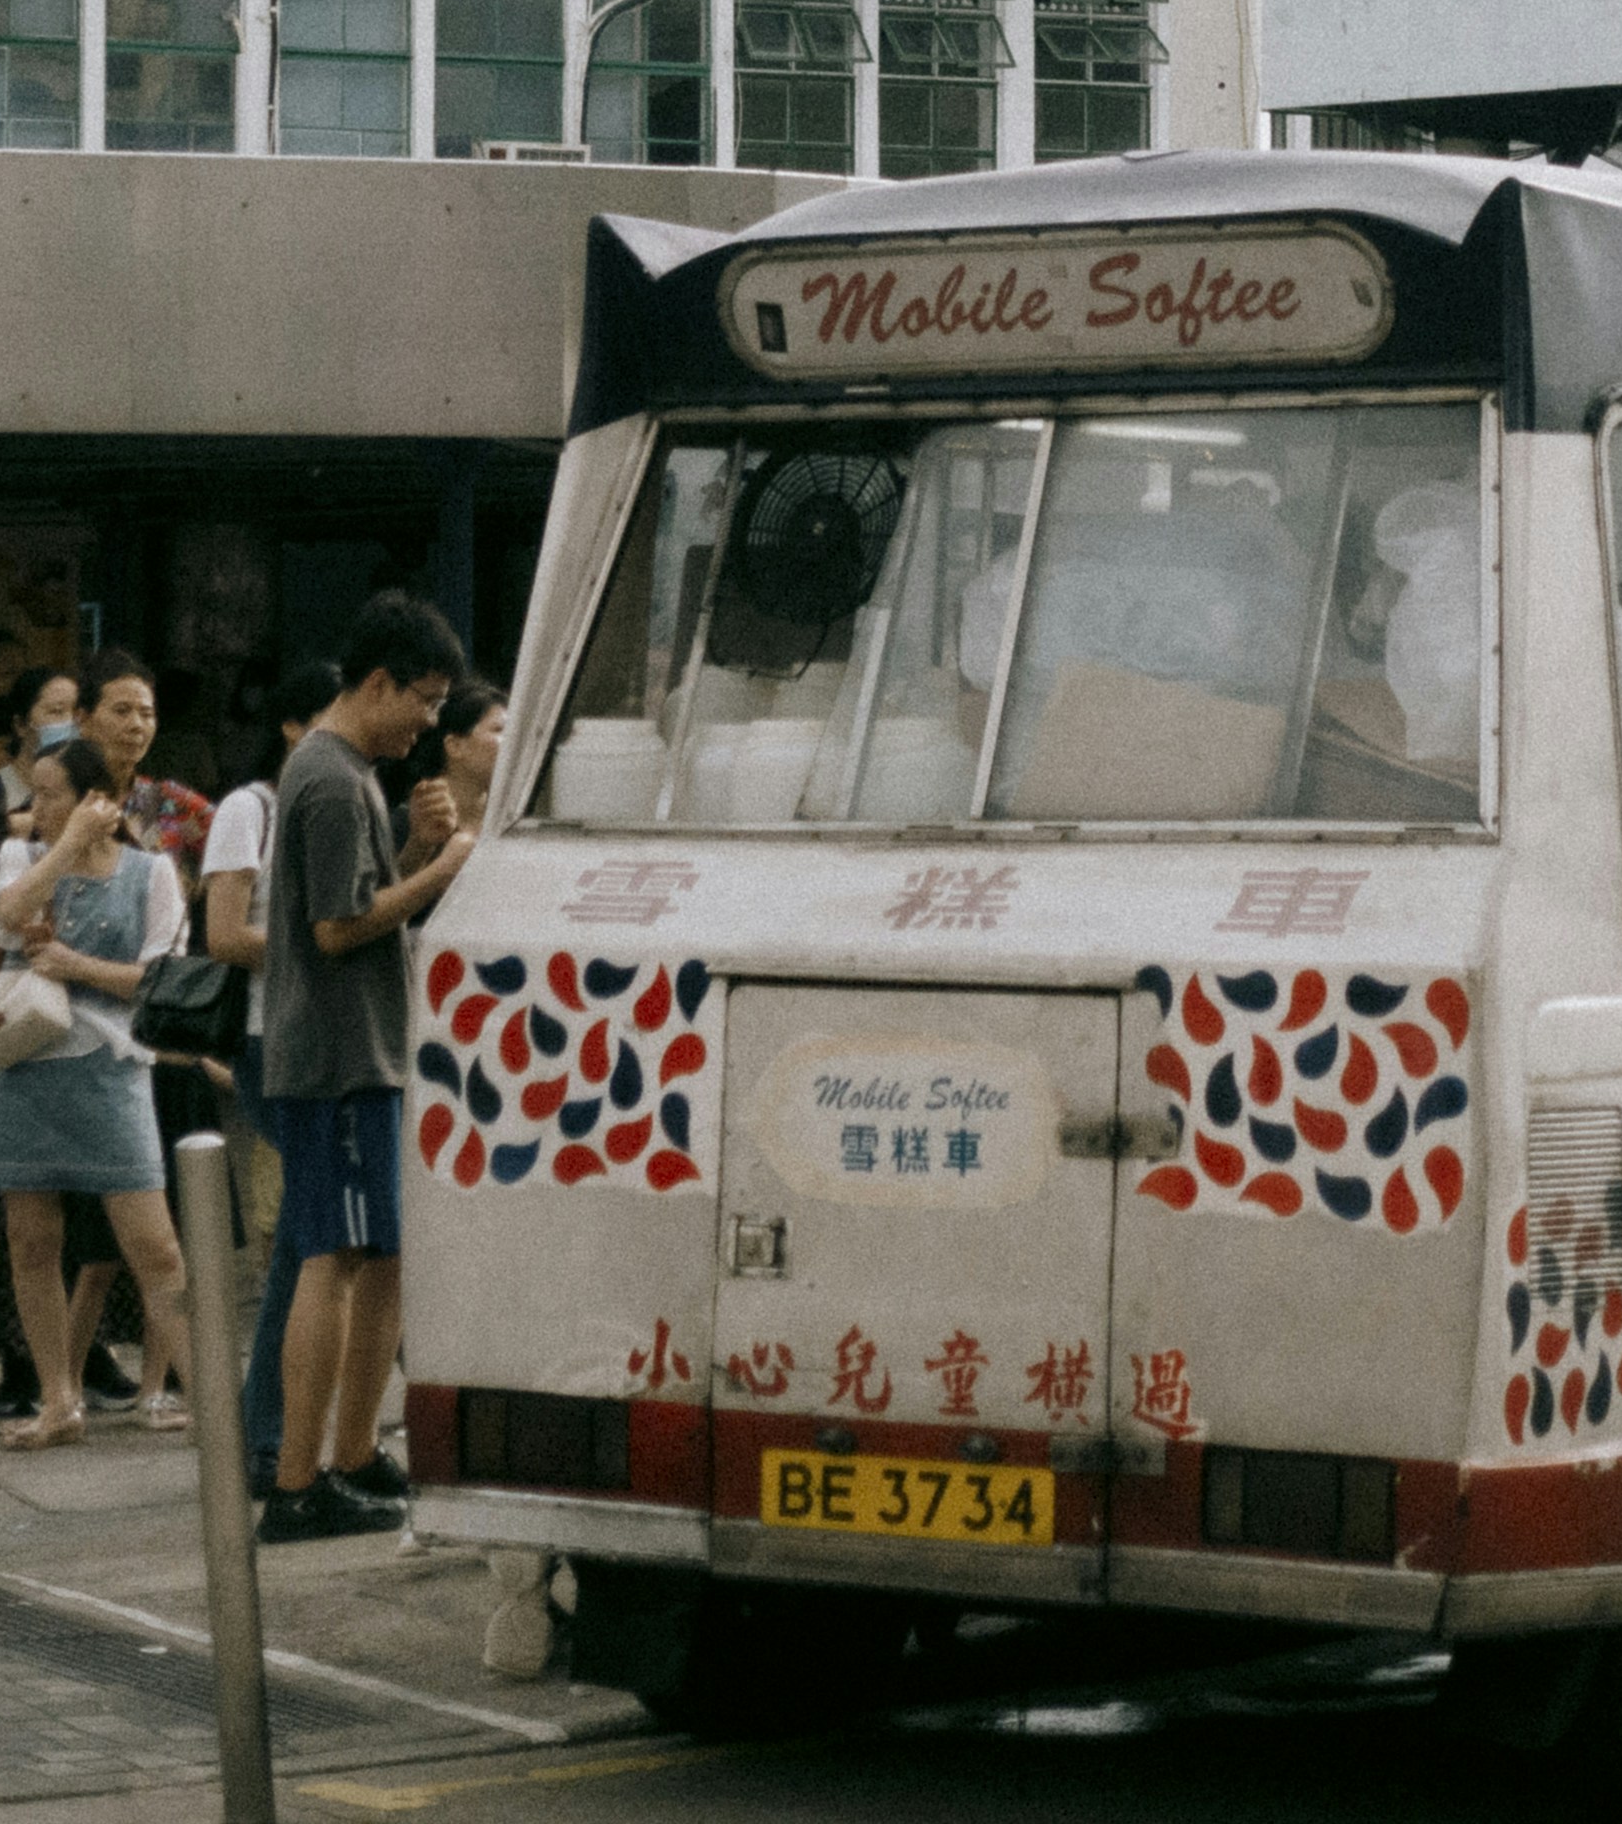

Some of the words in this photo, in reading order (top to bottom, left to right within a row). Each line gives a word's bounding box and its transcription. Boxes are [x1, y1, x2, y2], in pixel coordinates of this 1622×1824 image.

[801, 262, 1054, 344] Mobile
[1085, 251, 1302, 348] Softee
[813, 1075, 911, 1111] Mobile
[924, 1076, 1011, 1121] Softee
[840, 1124, 983, 1178] 雪糕車
[627, 1316, 1201, 1442] 小心兒童橫過
[779, 1462, 857, 1522] BE
[878, 1467, 1036, 1537] 3734
